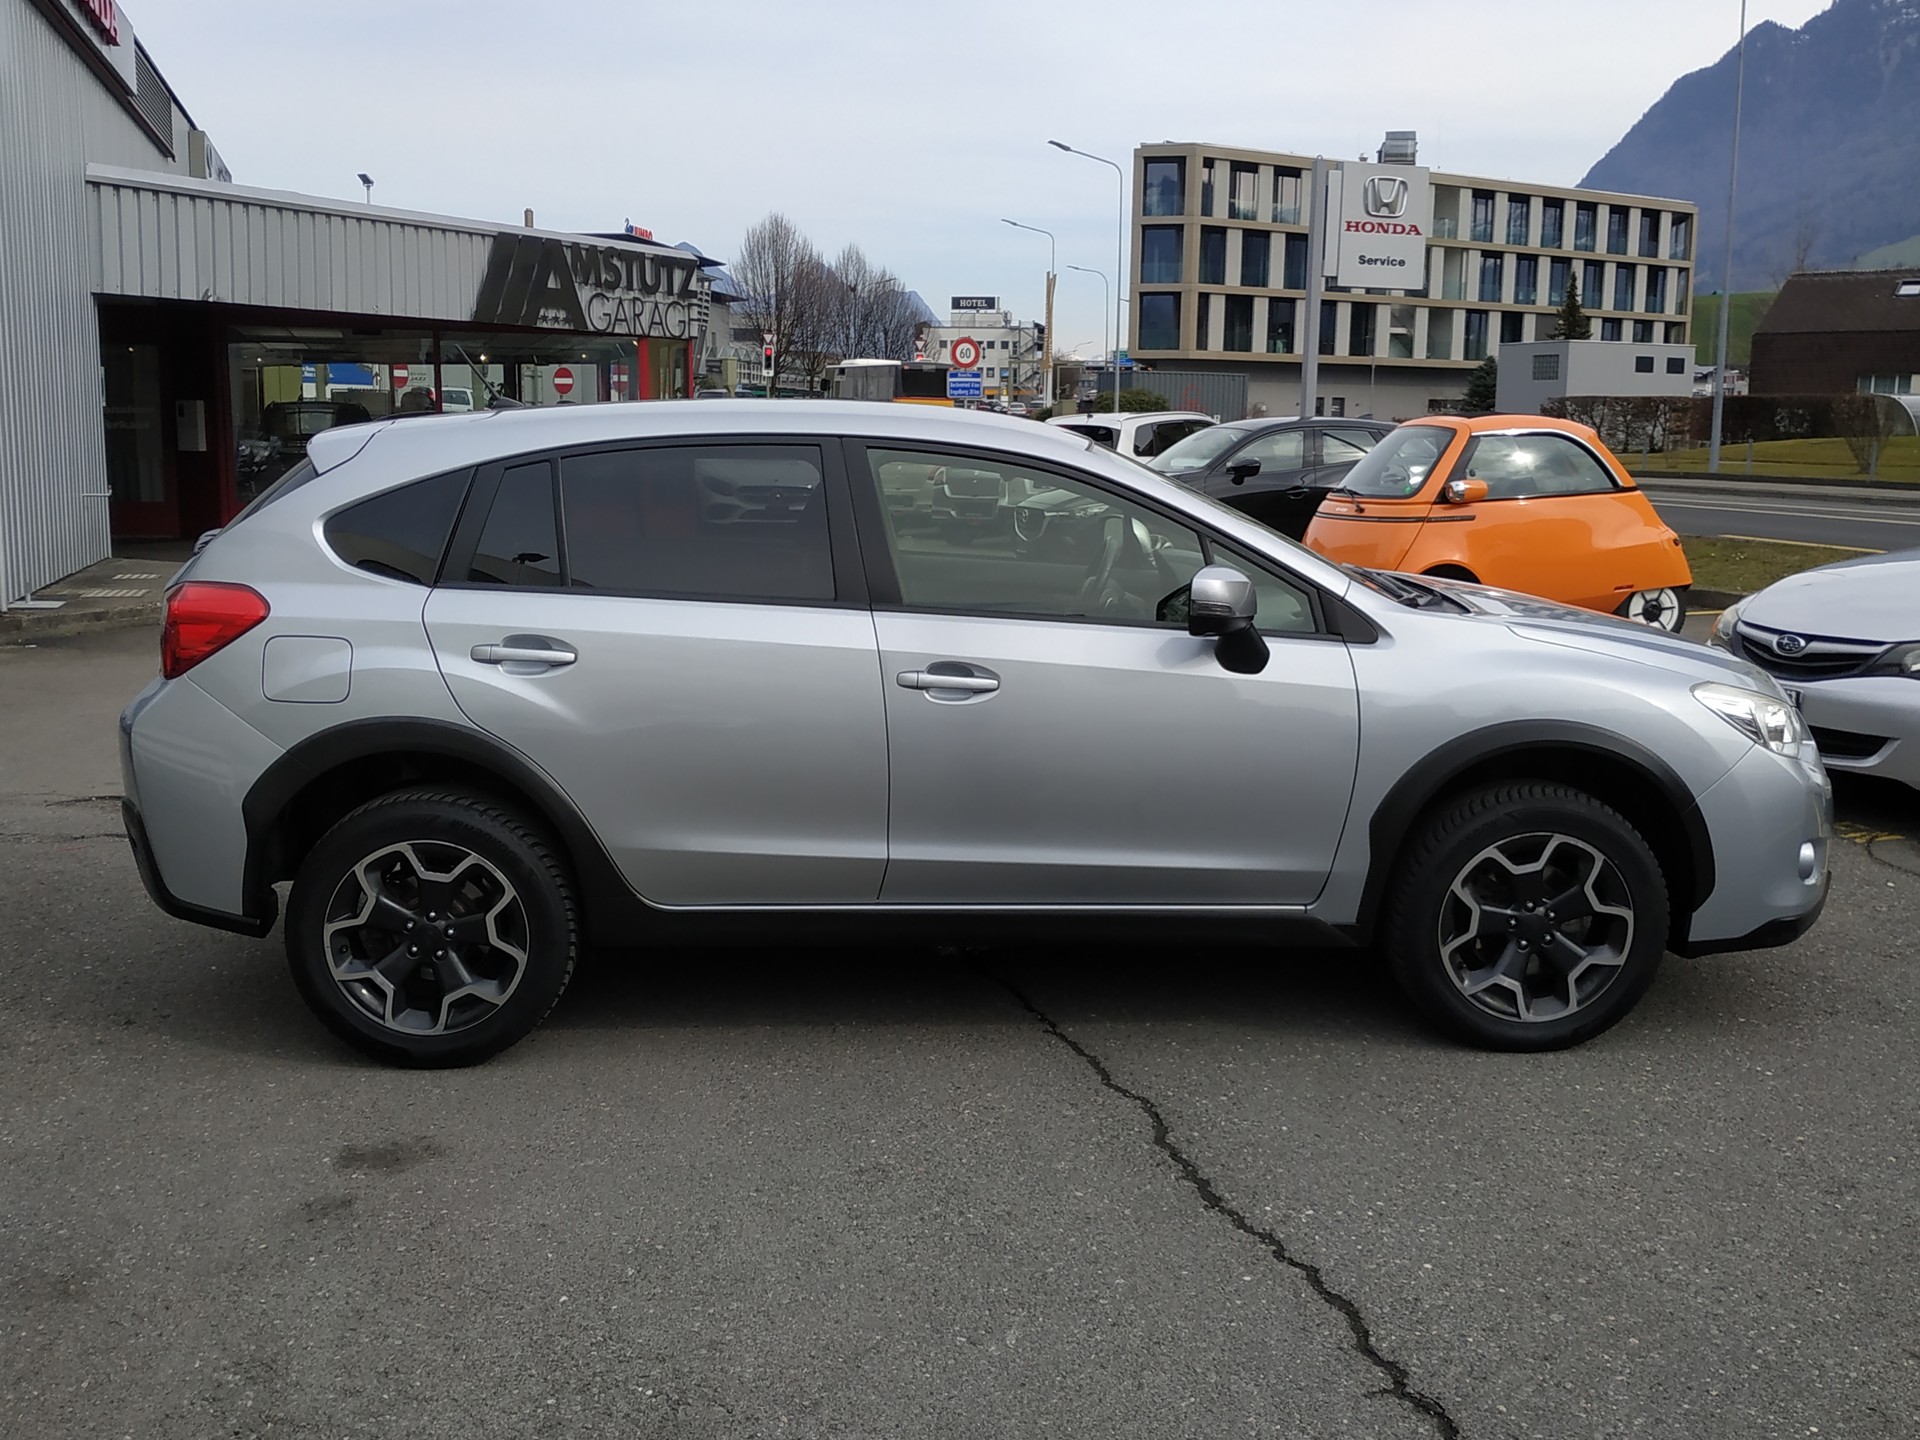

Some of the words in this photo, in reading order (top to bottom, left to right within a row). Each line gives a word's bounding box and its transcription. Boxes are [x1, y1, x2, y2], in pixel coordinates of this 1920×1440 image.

[1344, 220, 1423, 236] HONDA
[1358, 254, 1406, 268] Service
[959, 299, 988, 307] HOTEL
[588, 292, 699, 339] GARAGE
[959, 348, 972, 359] 60
